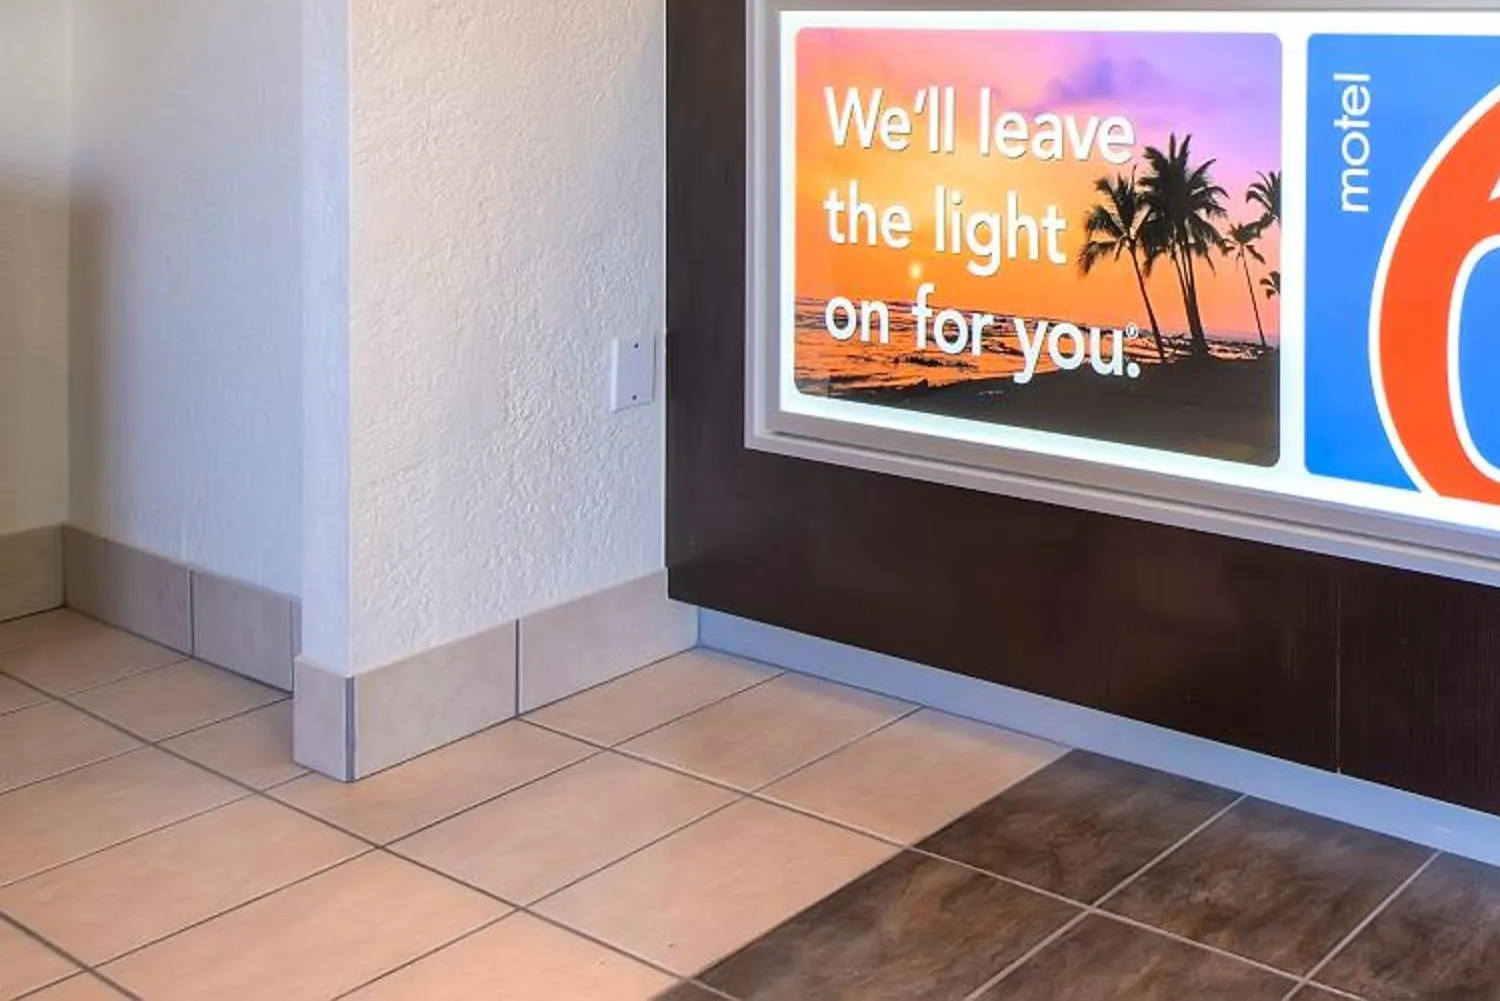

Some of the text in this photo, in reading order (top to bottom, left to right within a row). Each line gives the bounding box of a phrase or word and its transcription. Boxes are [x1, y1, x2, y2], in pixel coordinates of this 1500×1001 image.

[823, 84, 1136, 164] We'll leave
[1333, 72, 1370, 213] motel
[823, 181, 1067, 277] the light
[824, 294, 889, 344] on
[911, 282, 994, 356] for
